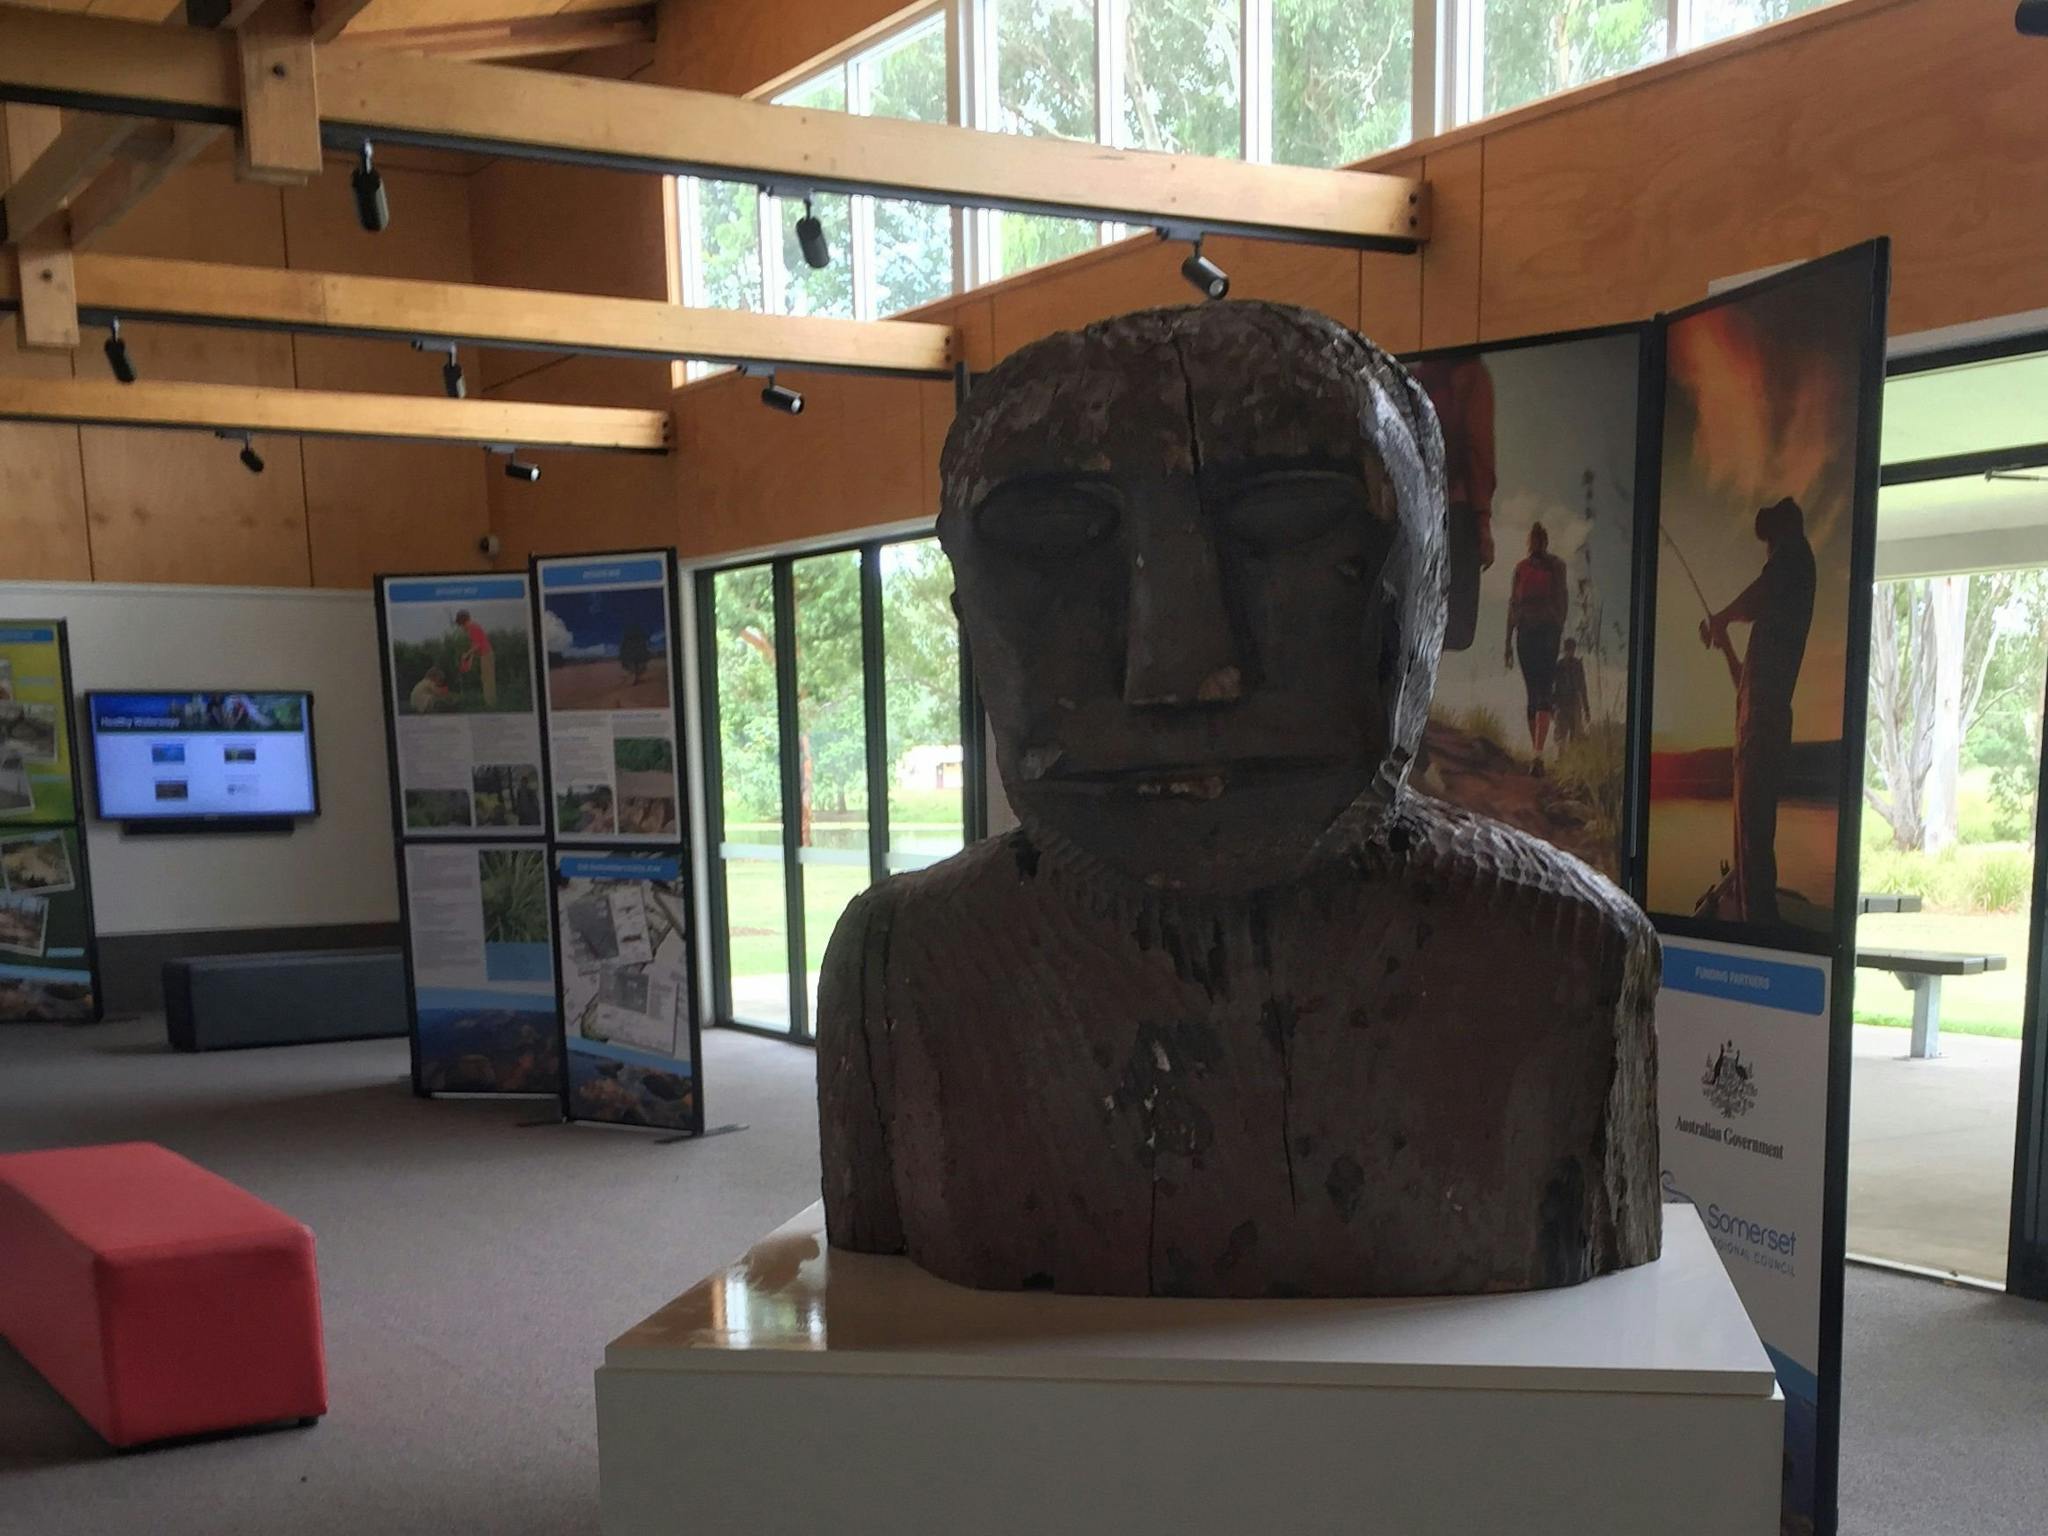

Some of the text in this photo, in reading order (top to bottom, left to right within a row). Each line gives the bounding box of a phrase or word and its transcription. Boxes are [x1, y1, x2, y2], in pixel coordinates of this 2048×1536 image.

[1695, 966, 1770, 991] FUNDING PARTNERS
[1675, 1115, 1784, 1160] Australian Government
[1708, 1203, 1797, 1257] Somerset
[1754, 1251, 1796, 1280] COUNCIL
